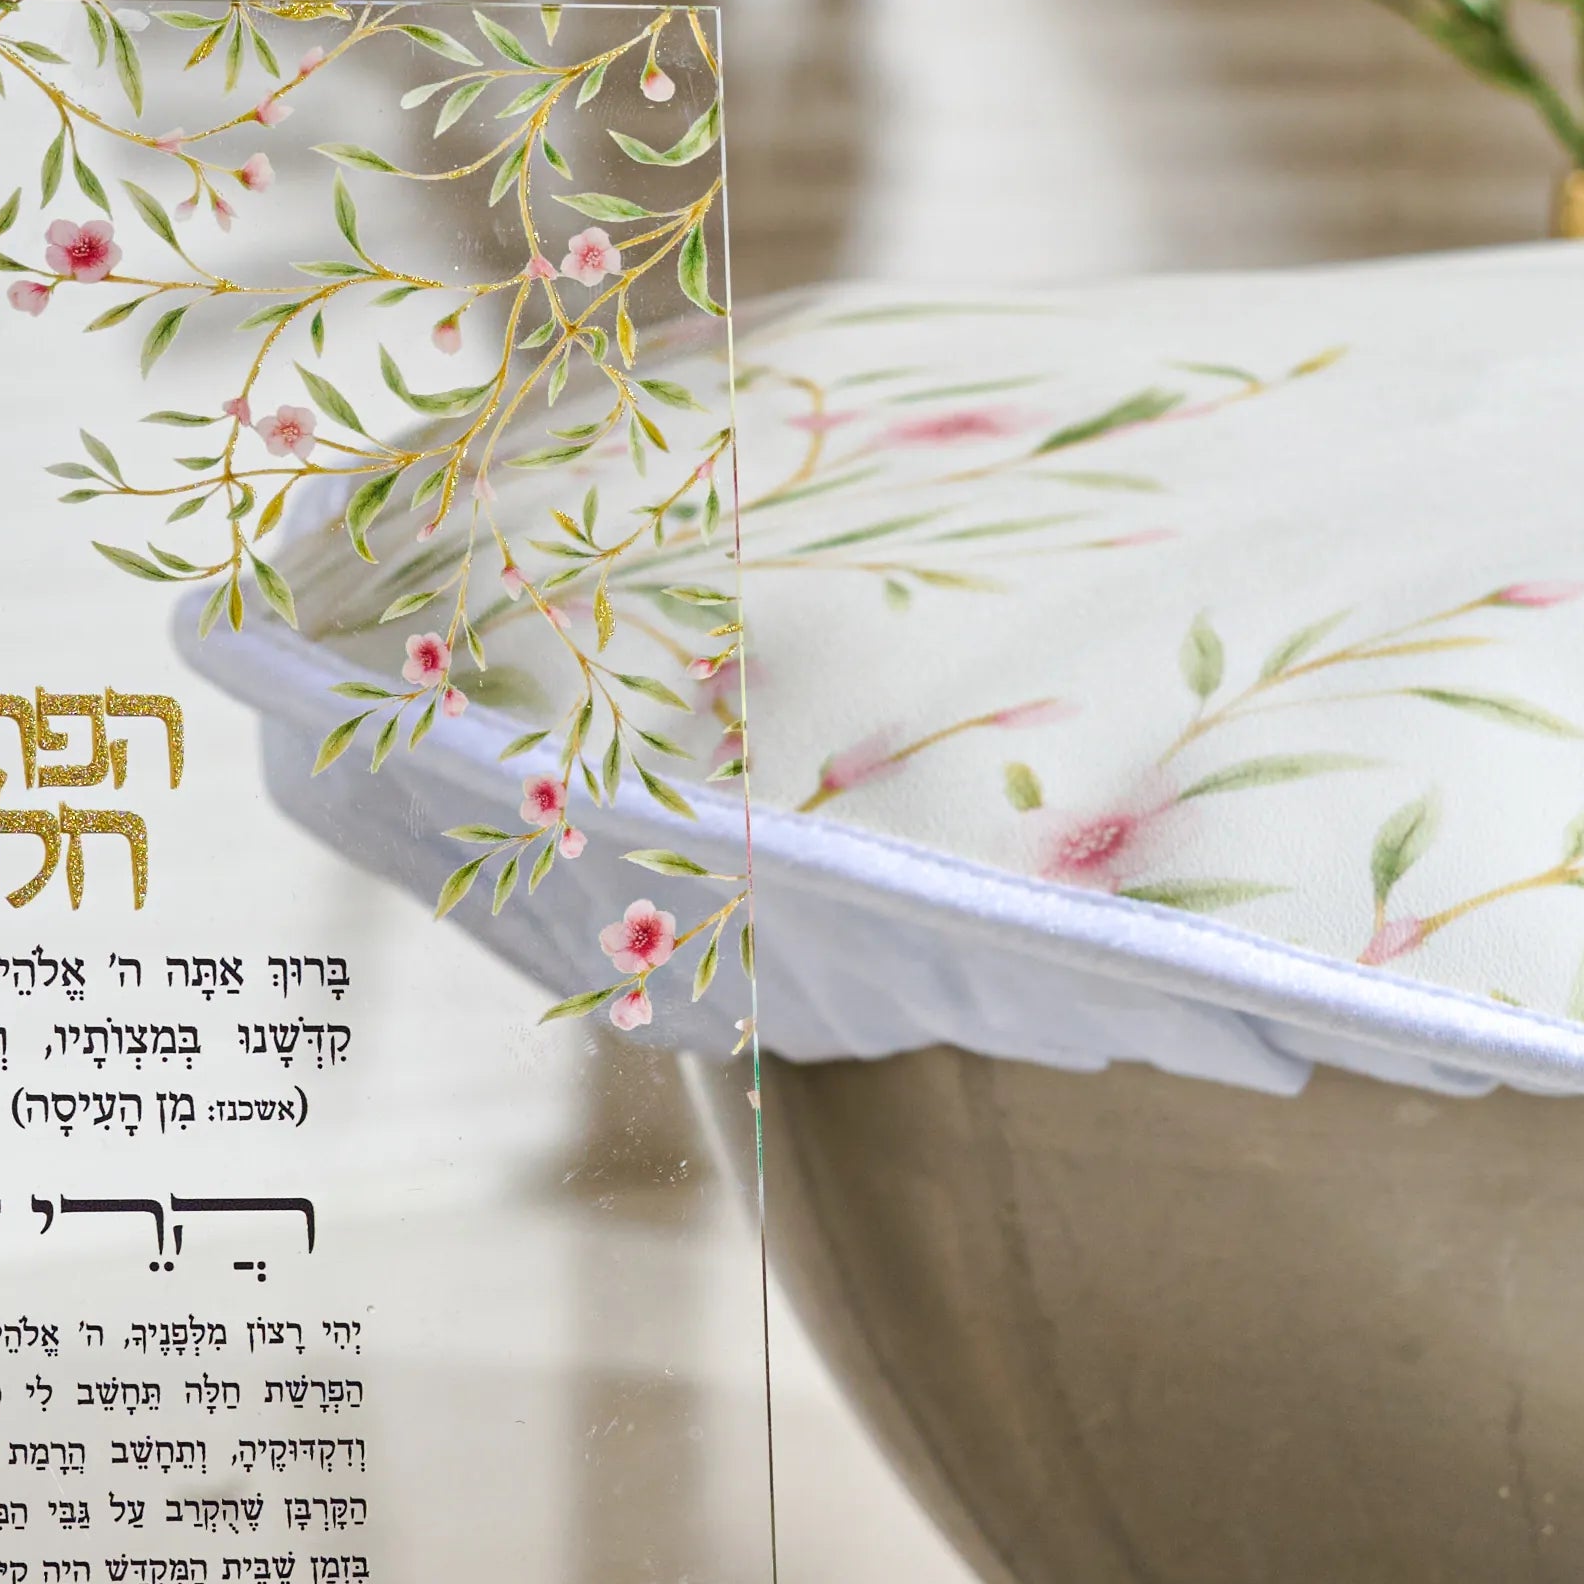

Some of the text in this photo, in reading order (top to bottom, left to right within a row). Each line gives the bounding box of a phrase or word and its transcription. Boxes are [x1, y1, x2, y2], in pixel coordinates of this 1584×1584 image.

[155, 1090, 196, 1135] מִן
[207, 1084, 309, 1128] (אשכנז:
[246, 1316, 306, 1356] רָצוֹן
[322, 1320, 361, 1355] יְהִי
[25, 1373, 53, 1413] לִי
[108, 1490, 146, 1529] עַל
